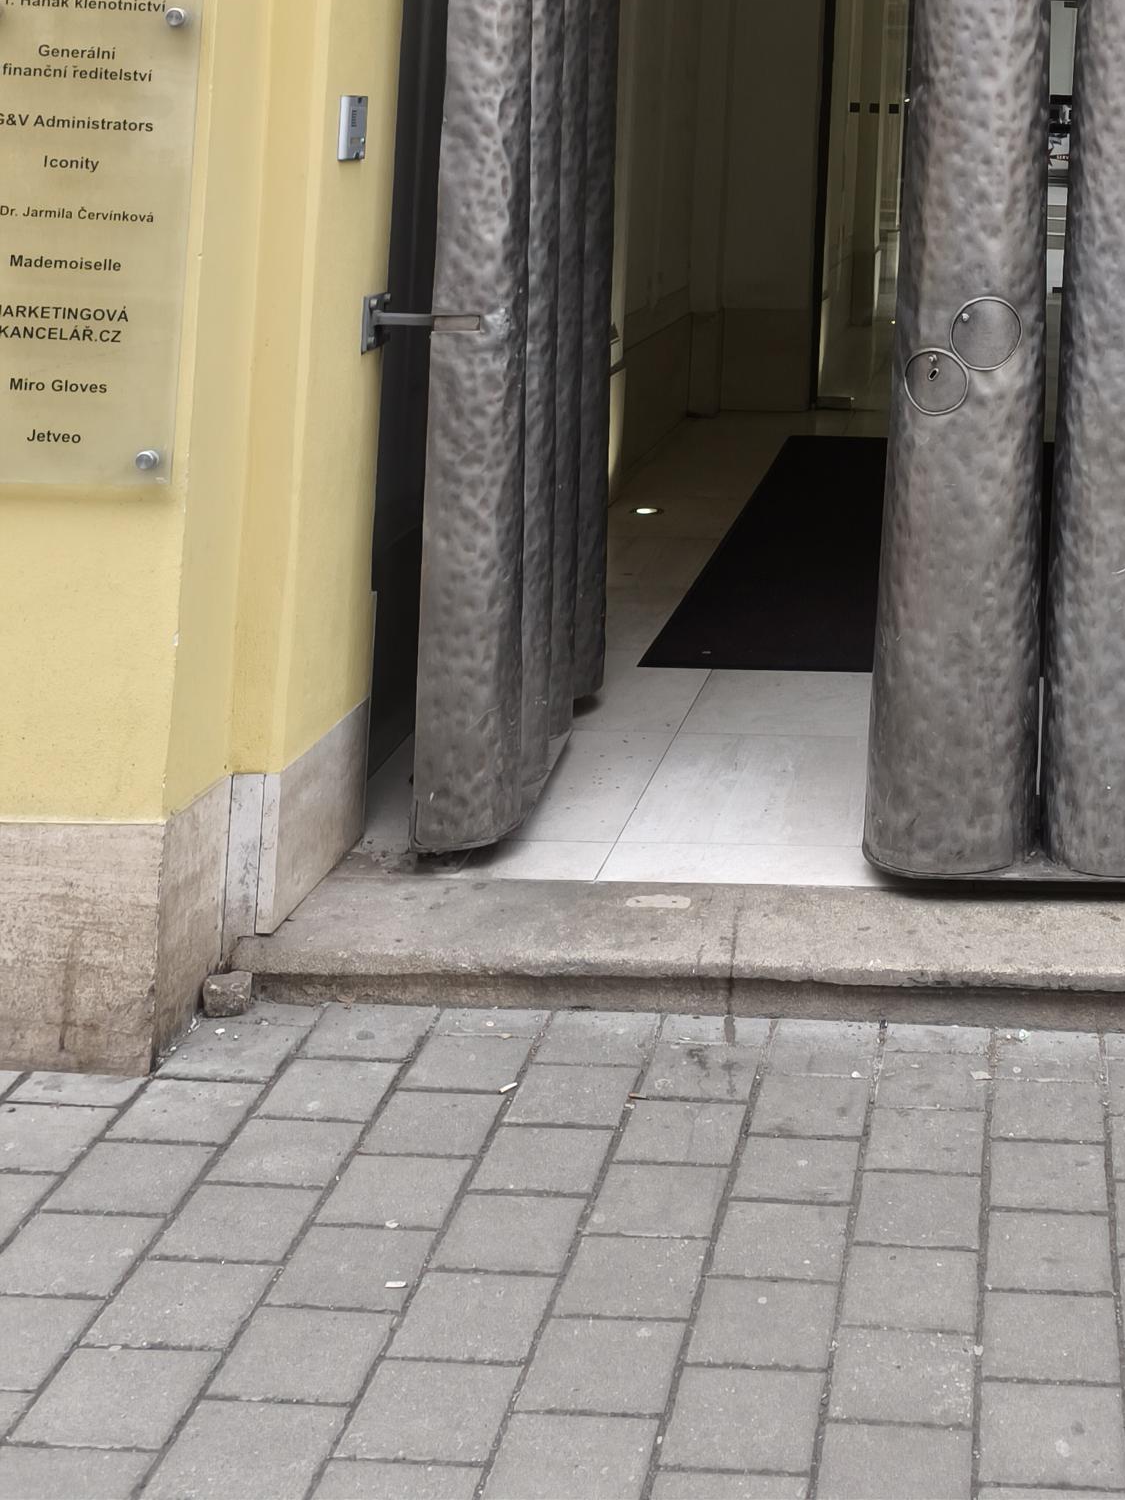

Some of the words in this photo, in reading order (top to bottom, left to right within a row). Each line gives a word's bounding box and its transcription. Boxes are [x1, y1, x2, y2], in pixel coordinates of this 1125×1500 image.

[39, 44, 115, 60] Generální
[3, 63, 67, 78] finanční
[73, 66, 152, 82] ředitelství
[33, 115, 153, 132] Administrators
[44, 156, 99, 172] Iconity
[23, 207, 72, 219] Jarmila
[78, 207, 153, 222] Červínková
[10, 255, 121, 271] Mademoiselle
[0, 305, 128, 322] ARKETINGOVÁ
[0, 325, 121, 342] KANCELÁŘ.CZ
[10, 378, 45, 391] Miro
[52, 380, 107, 393] Gloves
[27, 429, 81, 443] Jetveo
